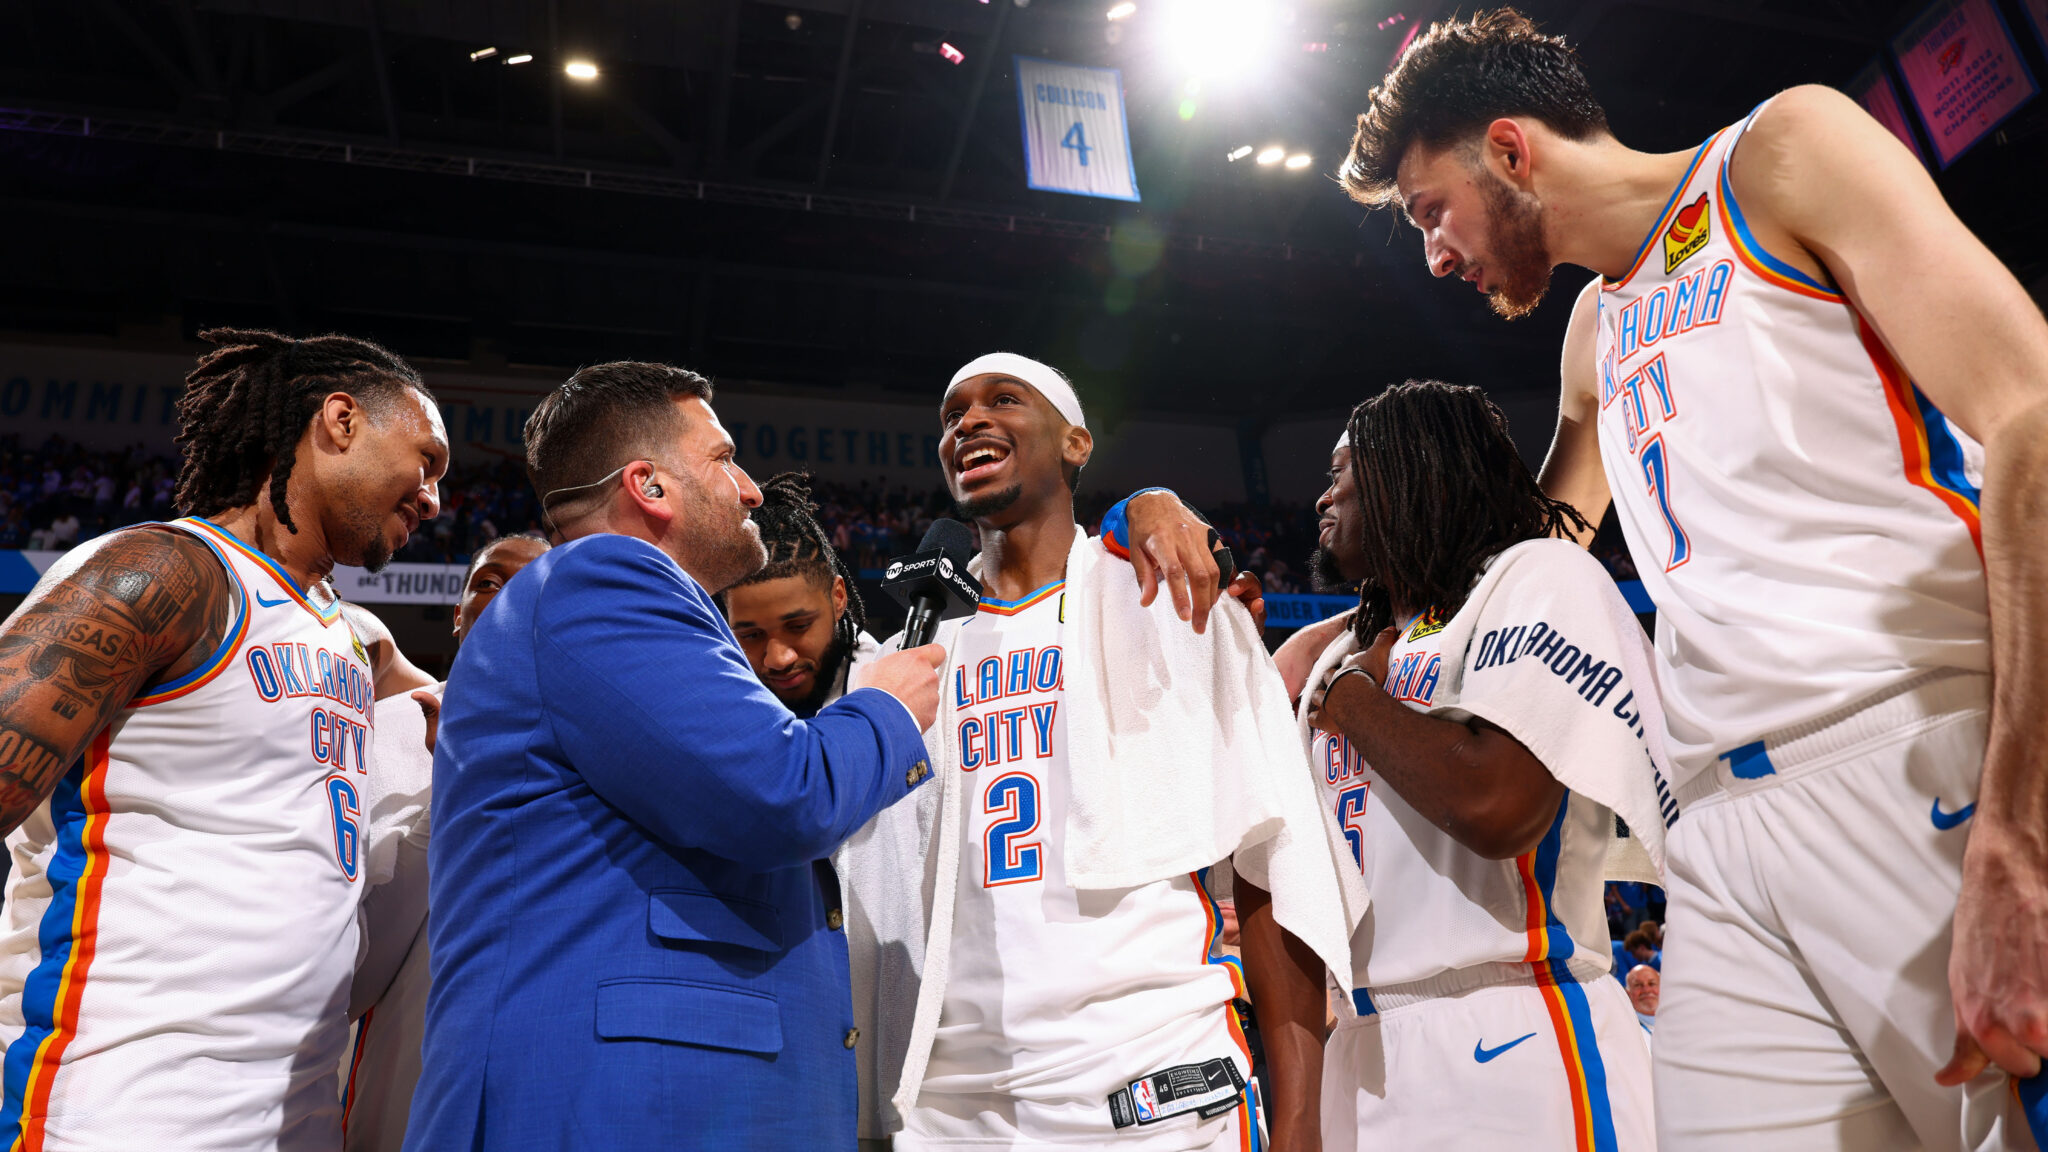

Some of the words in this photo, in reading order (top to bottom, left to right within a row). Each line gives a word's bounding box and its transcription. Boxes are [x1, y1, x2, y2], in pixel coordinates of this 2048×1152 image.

[1036, 83, 1107, 111] COLLISON
[1933, 53, 2004, 118] NORTHWEST
[1944, 75, 2014, 137] CHAMPIONS
[1947, 73, 2000, 120] DIVISION
[1061, 121, 1093, 166] 4
[730, 421, 941, 468] TOGETHER
[1639, 431, 1691, 573] 7
[886, 563, 903, 579] TNT
[903, 558, 936, 572] SPORTS
[939, 558, 954, 579] TNT
[953, 573, 980, 602] SPORTS
[956, 645, 1064, 711] LAHO
[1474, 621, 1623, 708] OKLAHOMA
[311, 707, 368, 775] CITY
[958, 700, 1058, 772] CITY
[325, 775, 361, 882] 6
[983, 771, 1043, 888] 2
